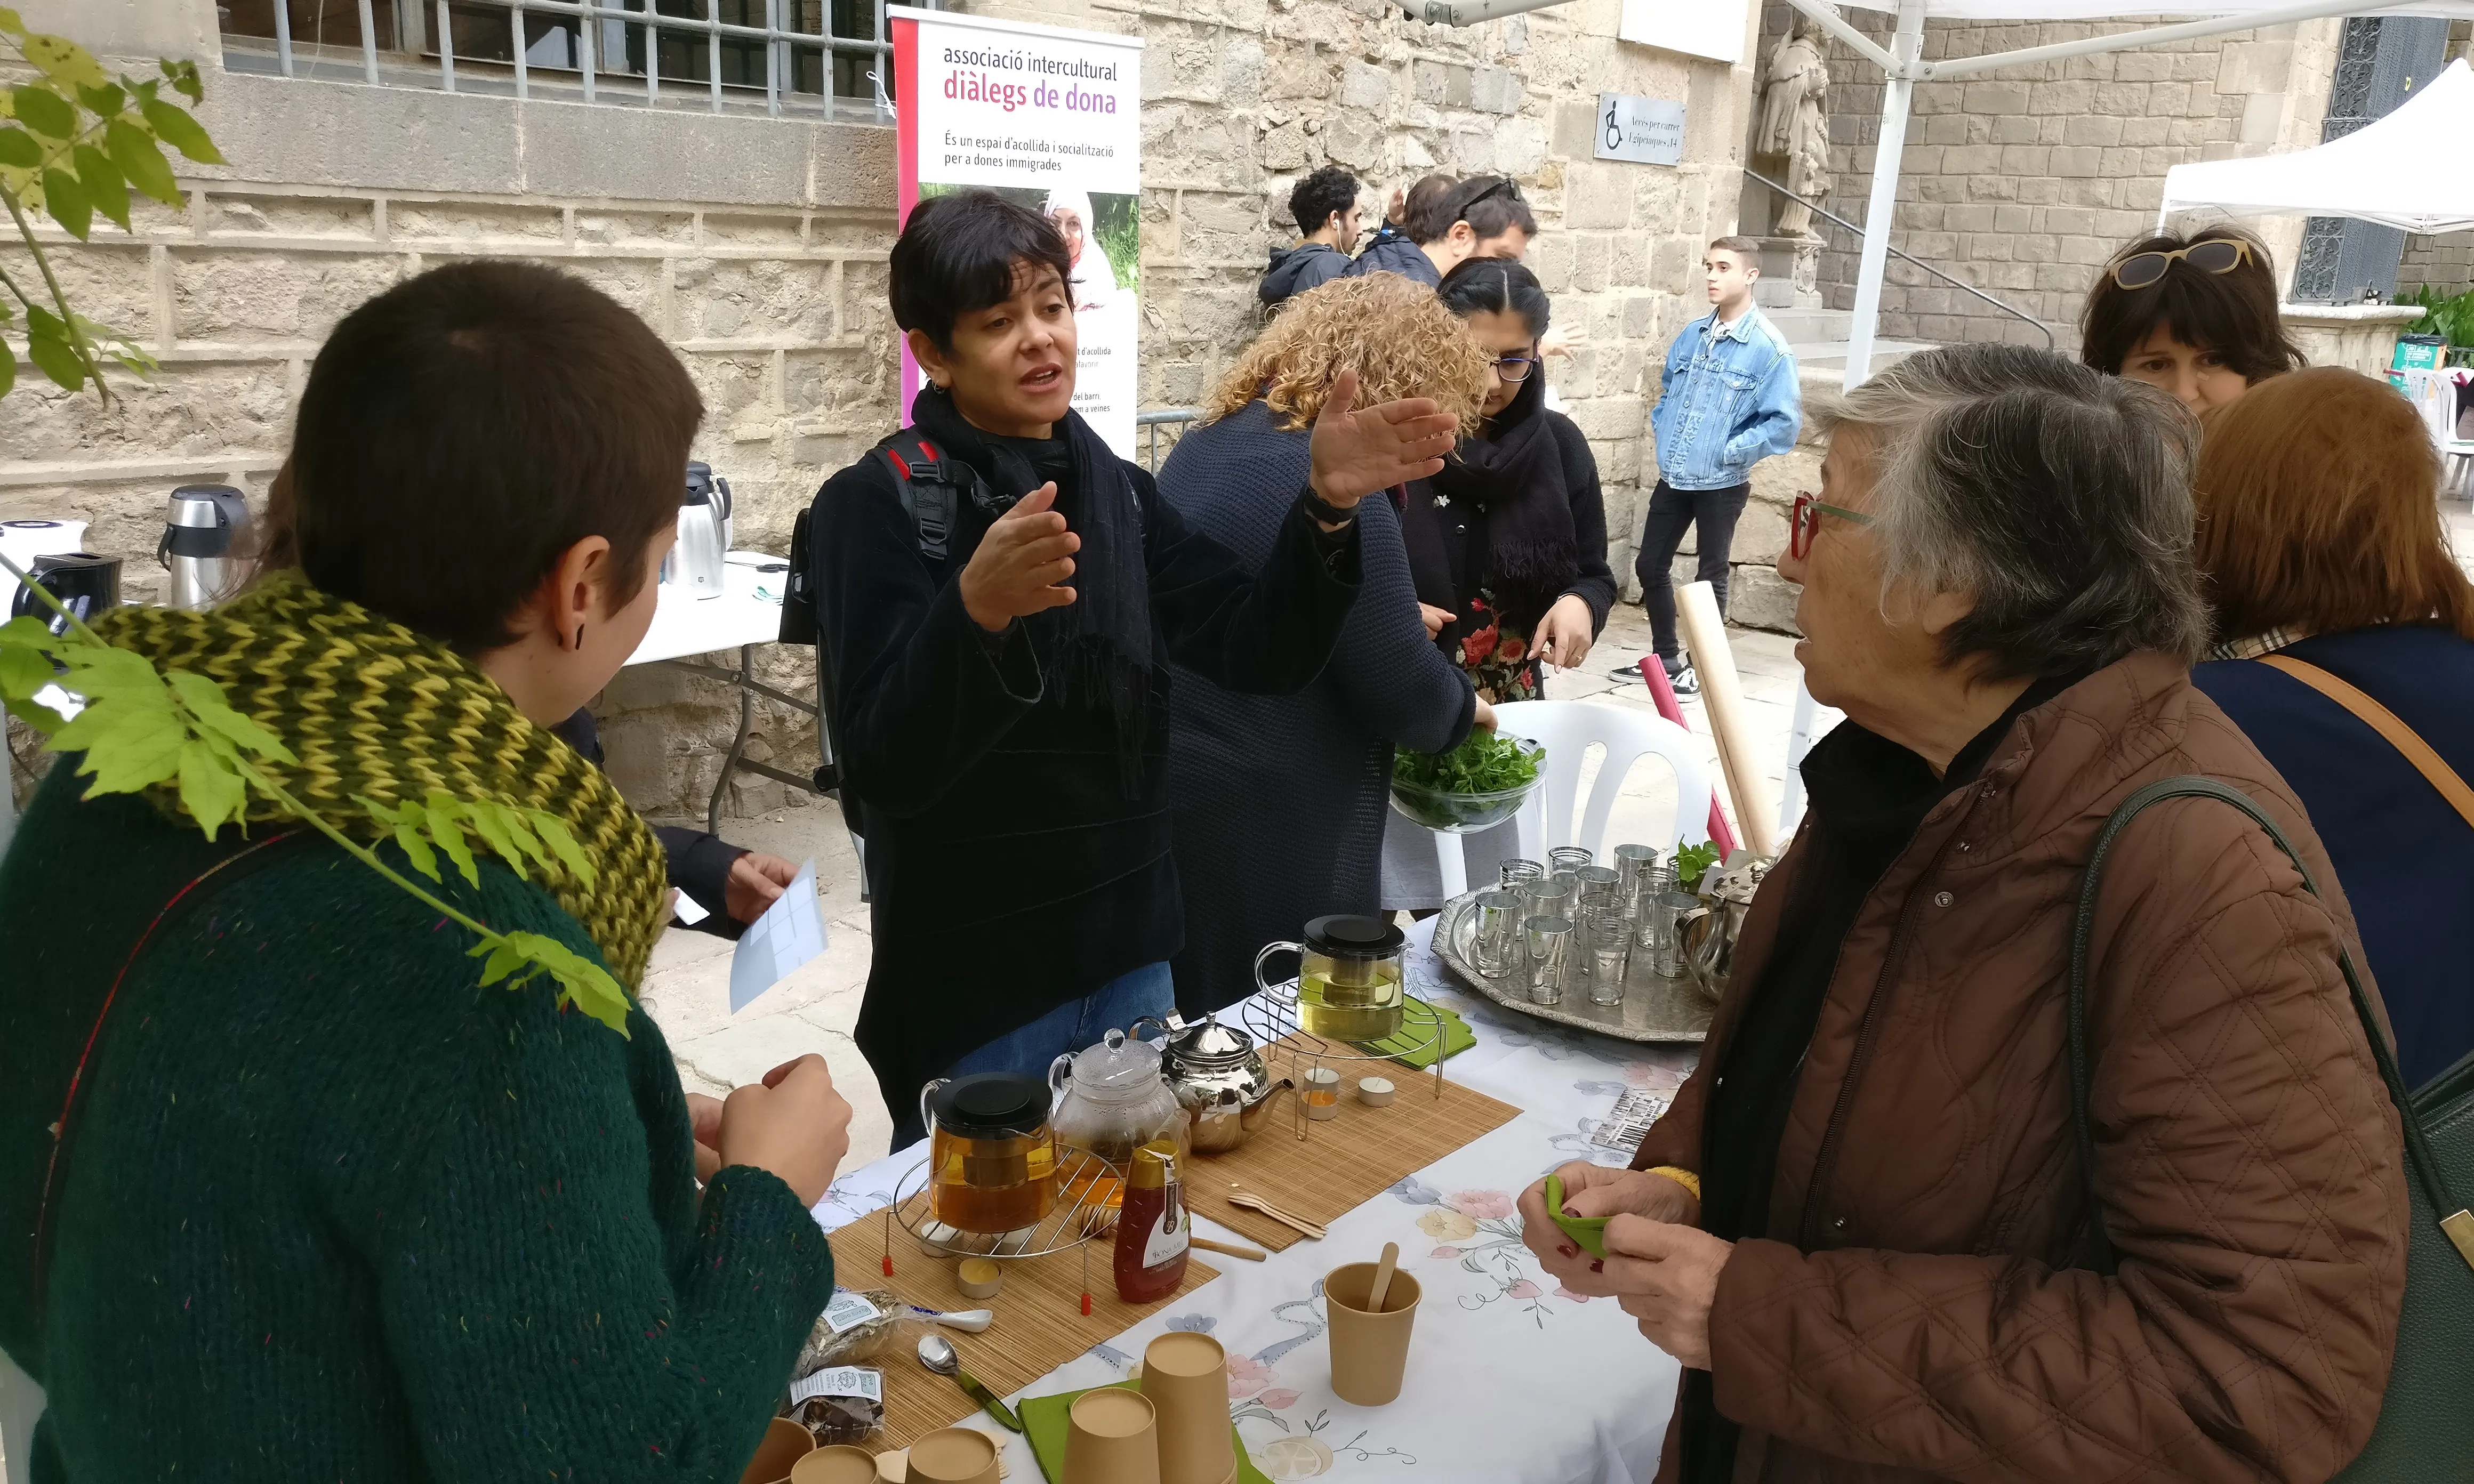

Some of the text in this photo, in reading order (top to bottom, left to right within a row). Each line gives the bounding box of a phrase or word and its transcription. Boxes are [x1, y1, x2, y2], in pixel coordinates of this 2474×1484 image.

[944, 46, 1117, 81] associació intercultural
[944, 70, 1116, 114] diàlegs de dona
[1632, 115, 1680, 132] Accés per carrer
[945, 130, 1114, 158] És un espai d'acollida i socialització
[945, 153, 1062, 173] per a dones immigrades
[1081, 346, 1111, 356] d'acollida
[1073, 392, 1083, 401] del
